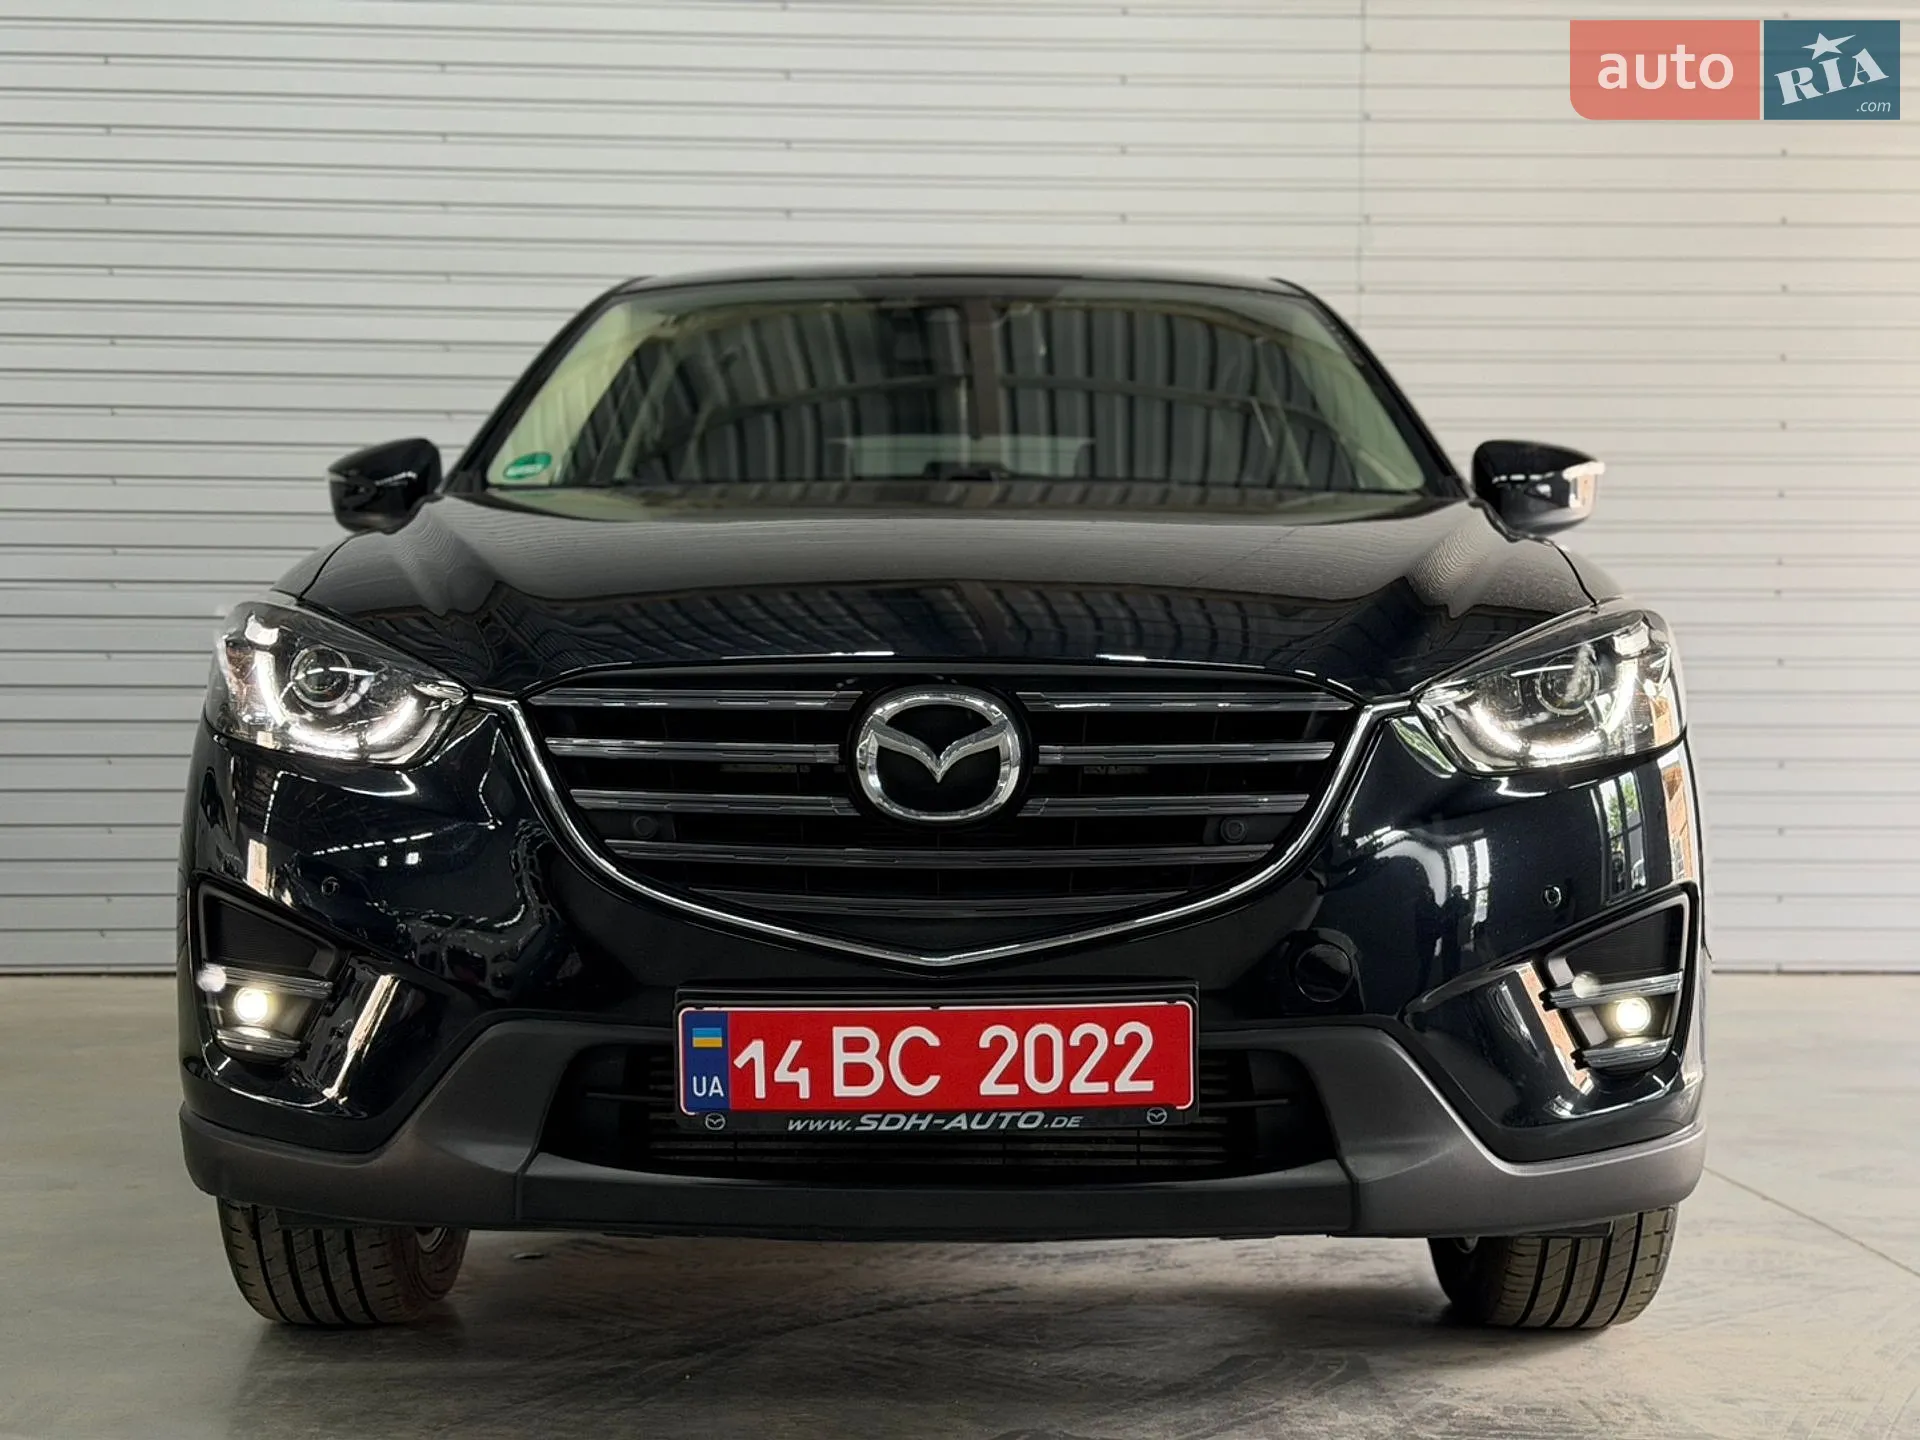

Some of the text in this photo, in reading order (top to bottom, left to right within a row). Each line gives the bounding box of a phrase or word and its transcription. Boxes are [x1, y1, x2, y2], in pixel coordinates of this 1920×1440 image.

[733, 1021, 1154, 1099] 14 BC 2022
[693, 1075, 724, 1097] UA
